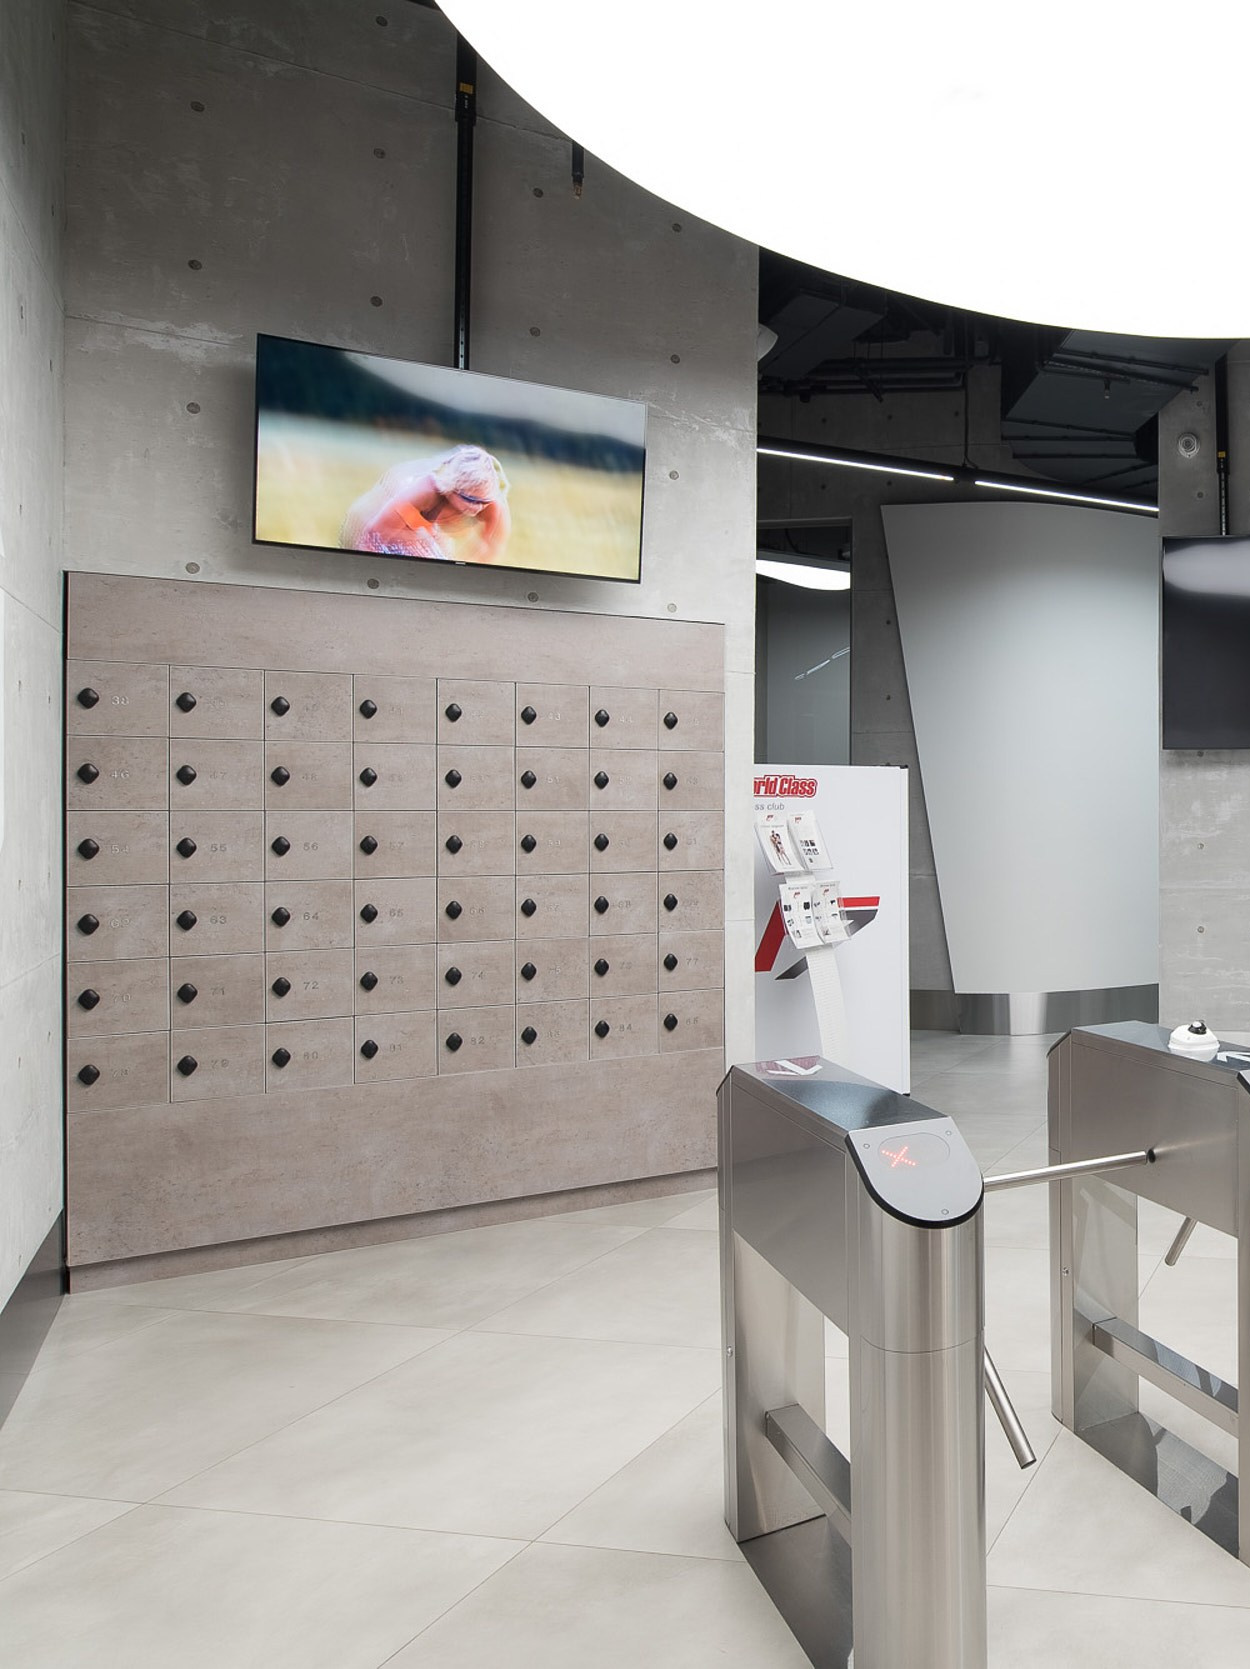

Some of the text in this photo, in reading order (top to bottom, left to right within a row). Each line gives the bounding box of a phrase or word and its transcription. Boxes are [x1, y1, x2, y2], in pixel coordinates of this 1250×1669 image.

[110, 770, 130, 779] 46
[778, 776, 816, 796] Class
[767, 802, 784, 811] club
[111, 845, 130, 855] 54
[210, 844, 228, 853] 55
[303, 842, 319, 851] 56
[303, 912, 319, 921] 64
[389, 909, 404, 918] 65
[210, 915, 227, 925] 63
[686, 958, 699, 967] 77
[471, 971, 485, 980] 74
[389, 976, 404, 985] 73
[303, 981, 319, 990] 72
[210, 987, 226, 996] 71
[619, 1022, 633, 1032] 84
[471, 1036, 485, 1046] 82
